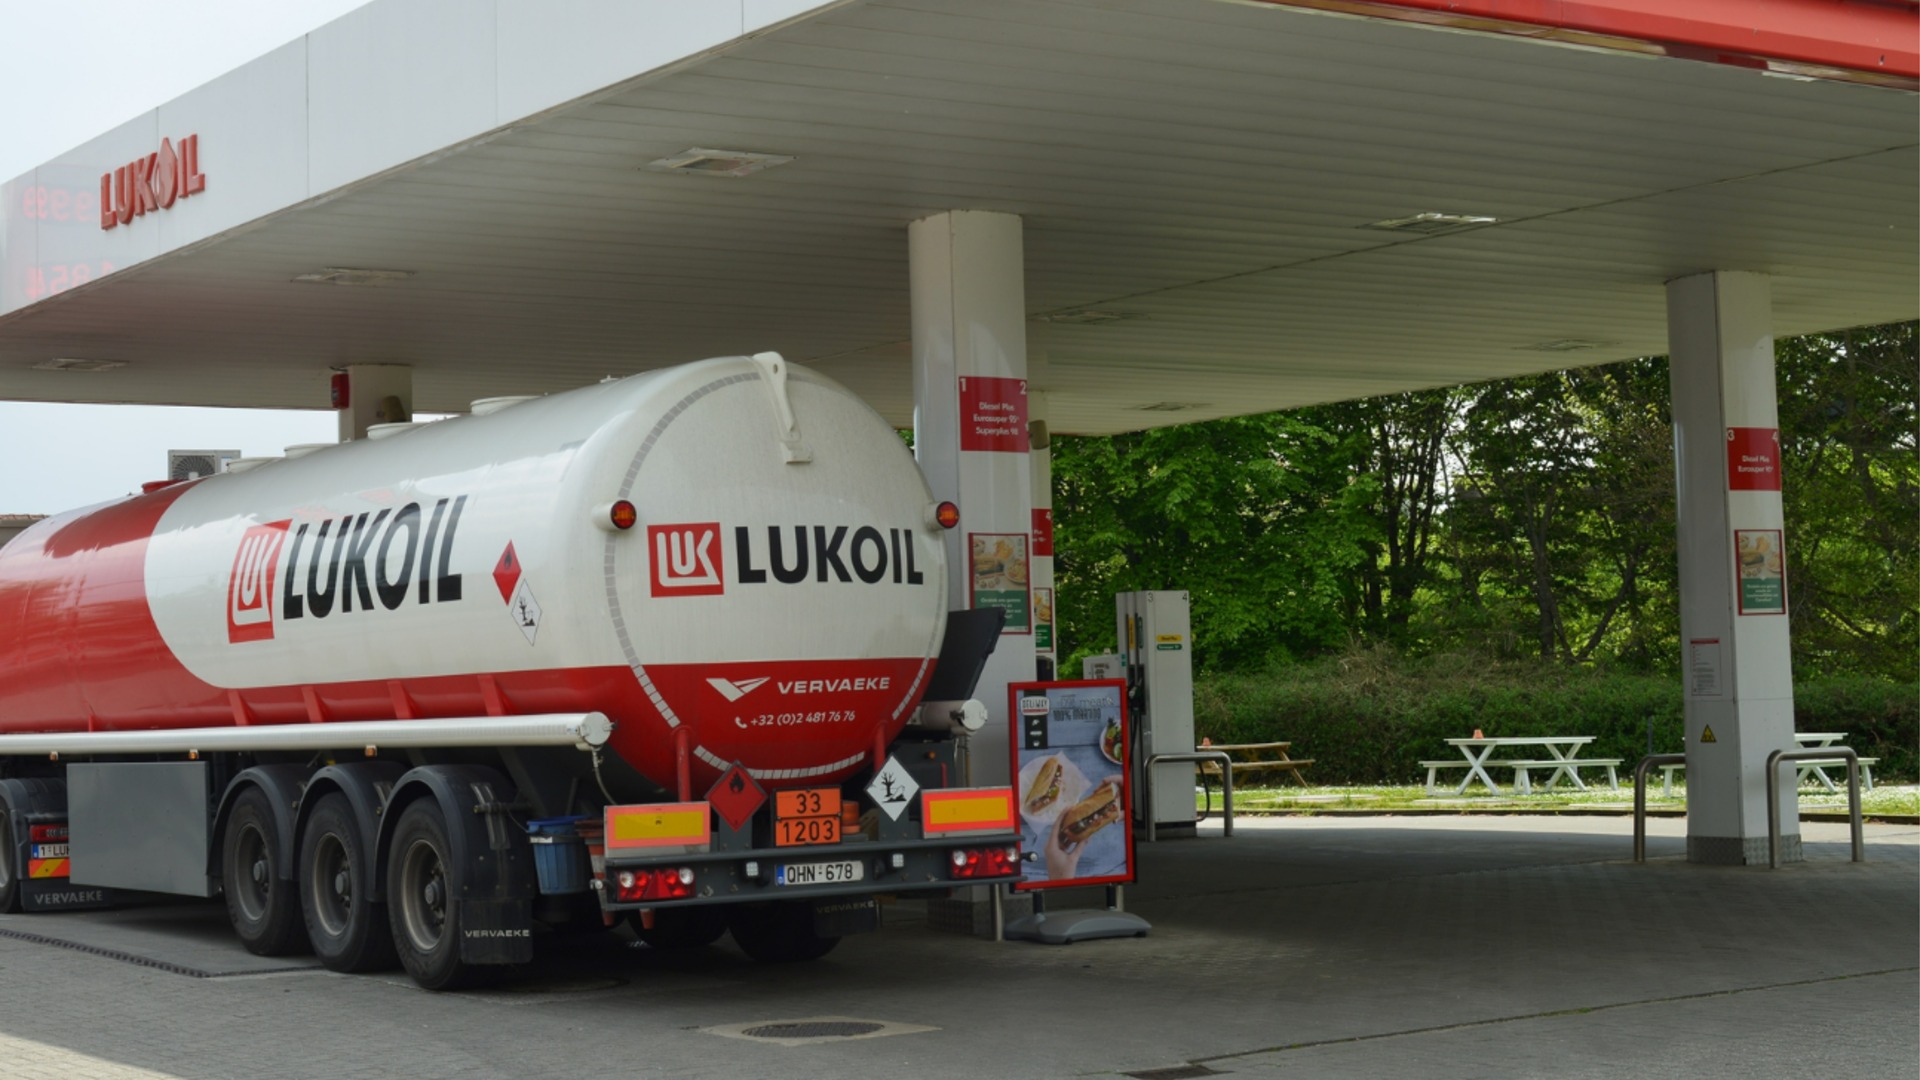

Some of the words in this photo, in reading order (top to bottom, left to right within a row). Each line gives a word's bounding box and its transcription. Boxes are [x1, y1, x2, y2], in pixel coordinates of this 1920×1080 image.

[101, 134, 205, 230] LUKOIL
[960, 378, 967, 392] 1
[1019, 381, 1027, 395] 2
[1727, 429, 1735, 441] 3
[231, 530, 283, 626] LUK
[283, 494, 469, 620] LUKOIL
[655, 529, 722, 588] LUK
[734, 525, 924, 585] LUKOIL
[777, 677, 891, 695] VERVAEKE
[750, 714, 774, 727] +32
[776, 712, 803, 728] (0)2
[805, 712, 826, 723] 481
[828, 711, 841, 723] 76
[842, 710, 856, 722] 76
[796, 792, 822, 814] 33
[782, 820, 834, 843] 1203
[34, 890, 104, 905] VERVAEKE
[816, 900, 874, 913] VERVAEKE
[464, 929, 531, 938] VERVAEKE
